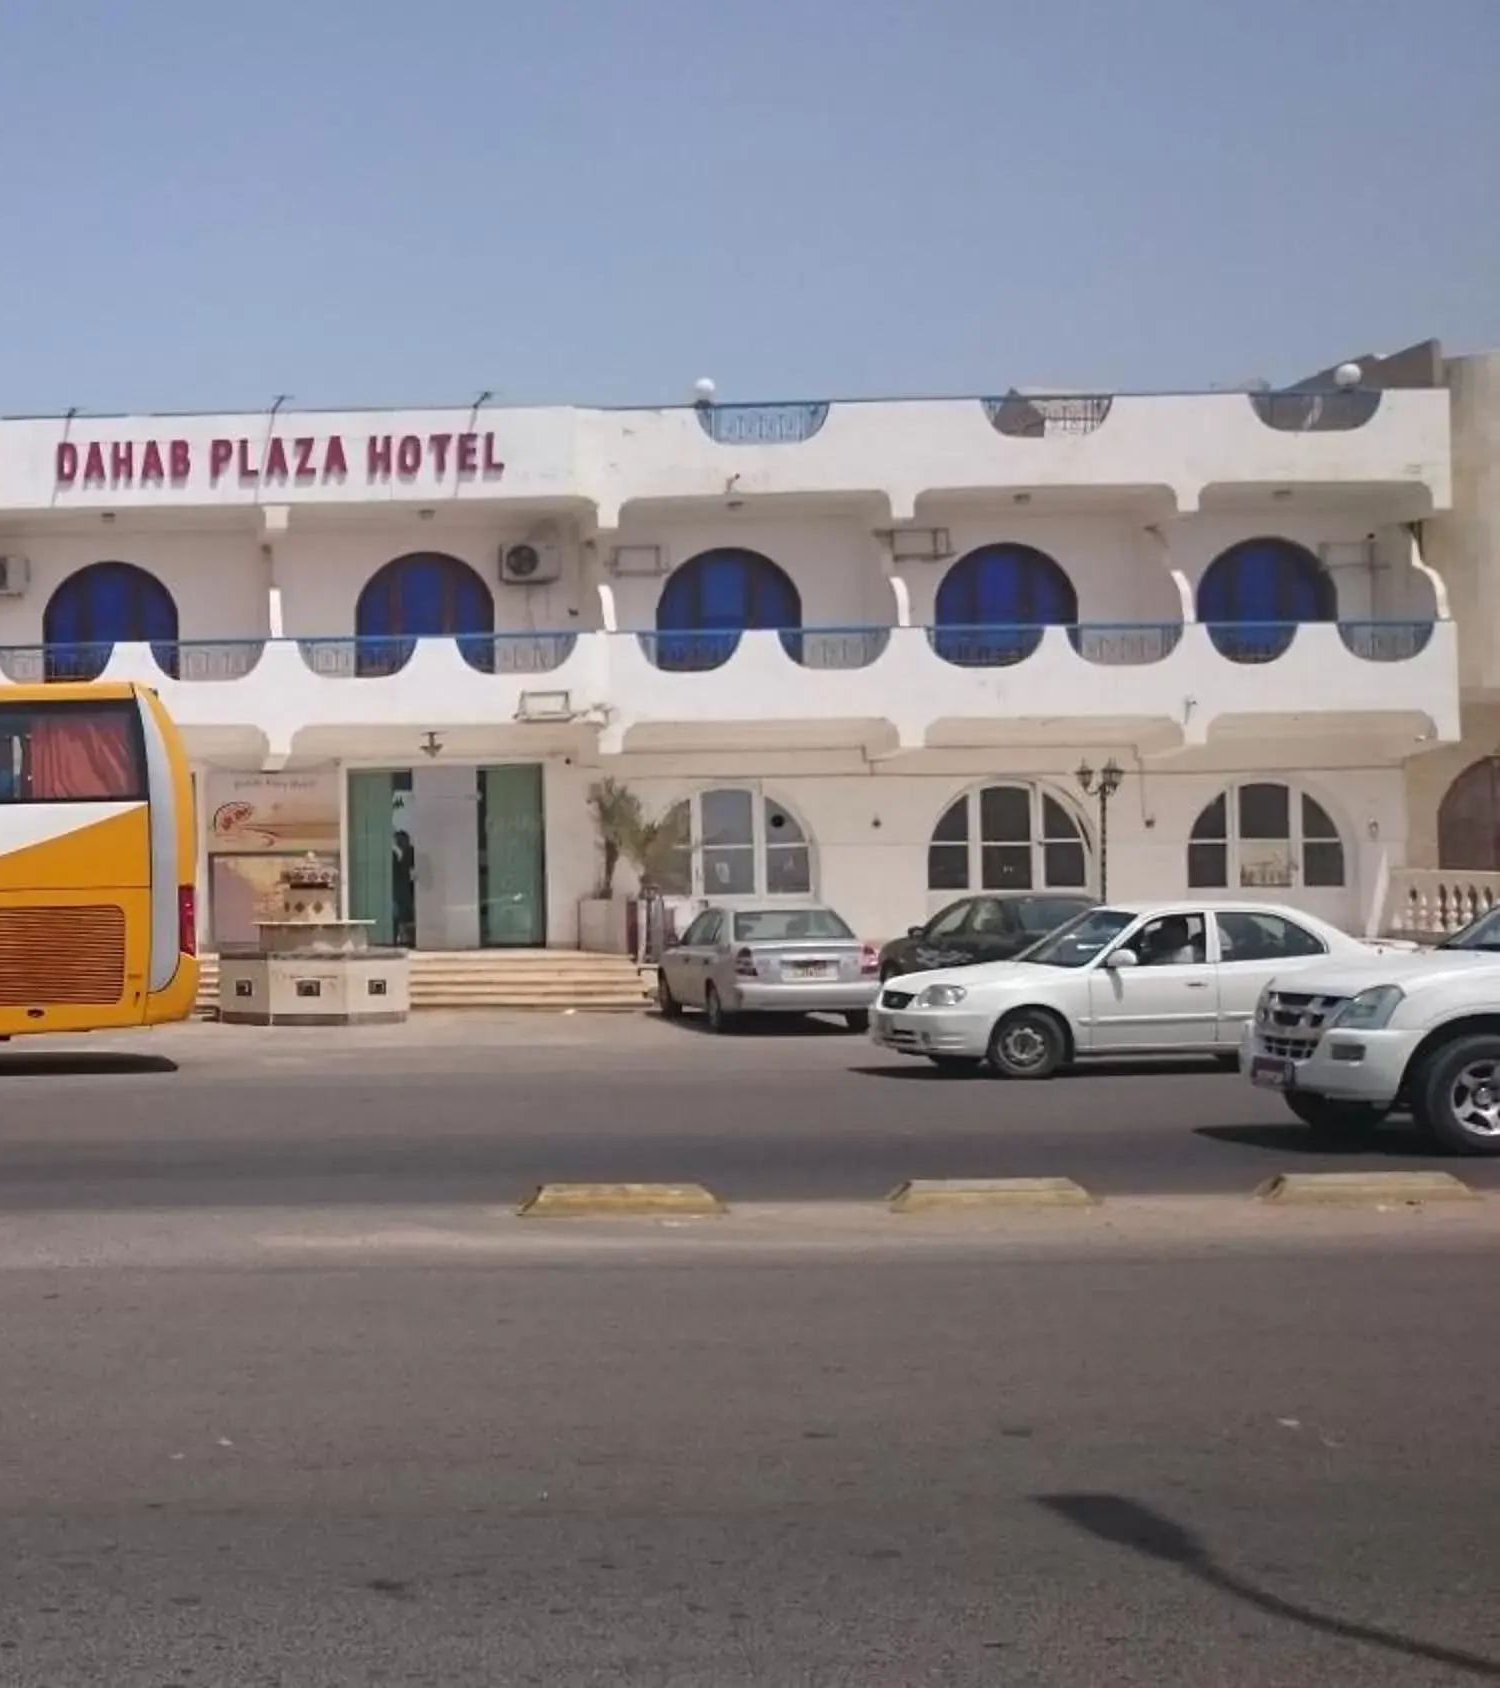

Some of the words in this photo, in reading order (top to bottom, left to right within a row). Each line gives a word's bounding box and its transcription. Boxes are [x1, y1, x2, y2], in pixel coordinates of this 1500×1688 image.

[56, 440, 191, 482] DAHAB
[210, 436, 348, 478] PLAZA
[367, 431, 505, 475] HOTEL
